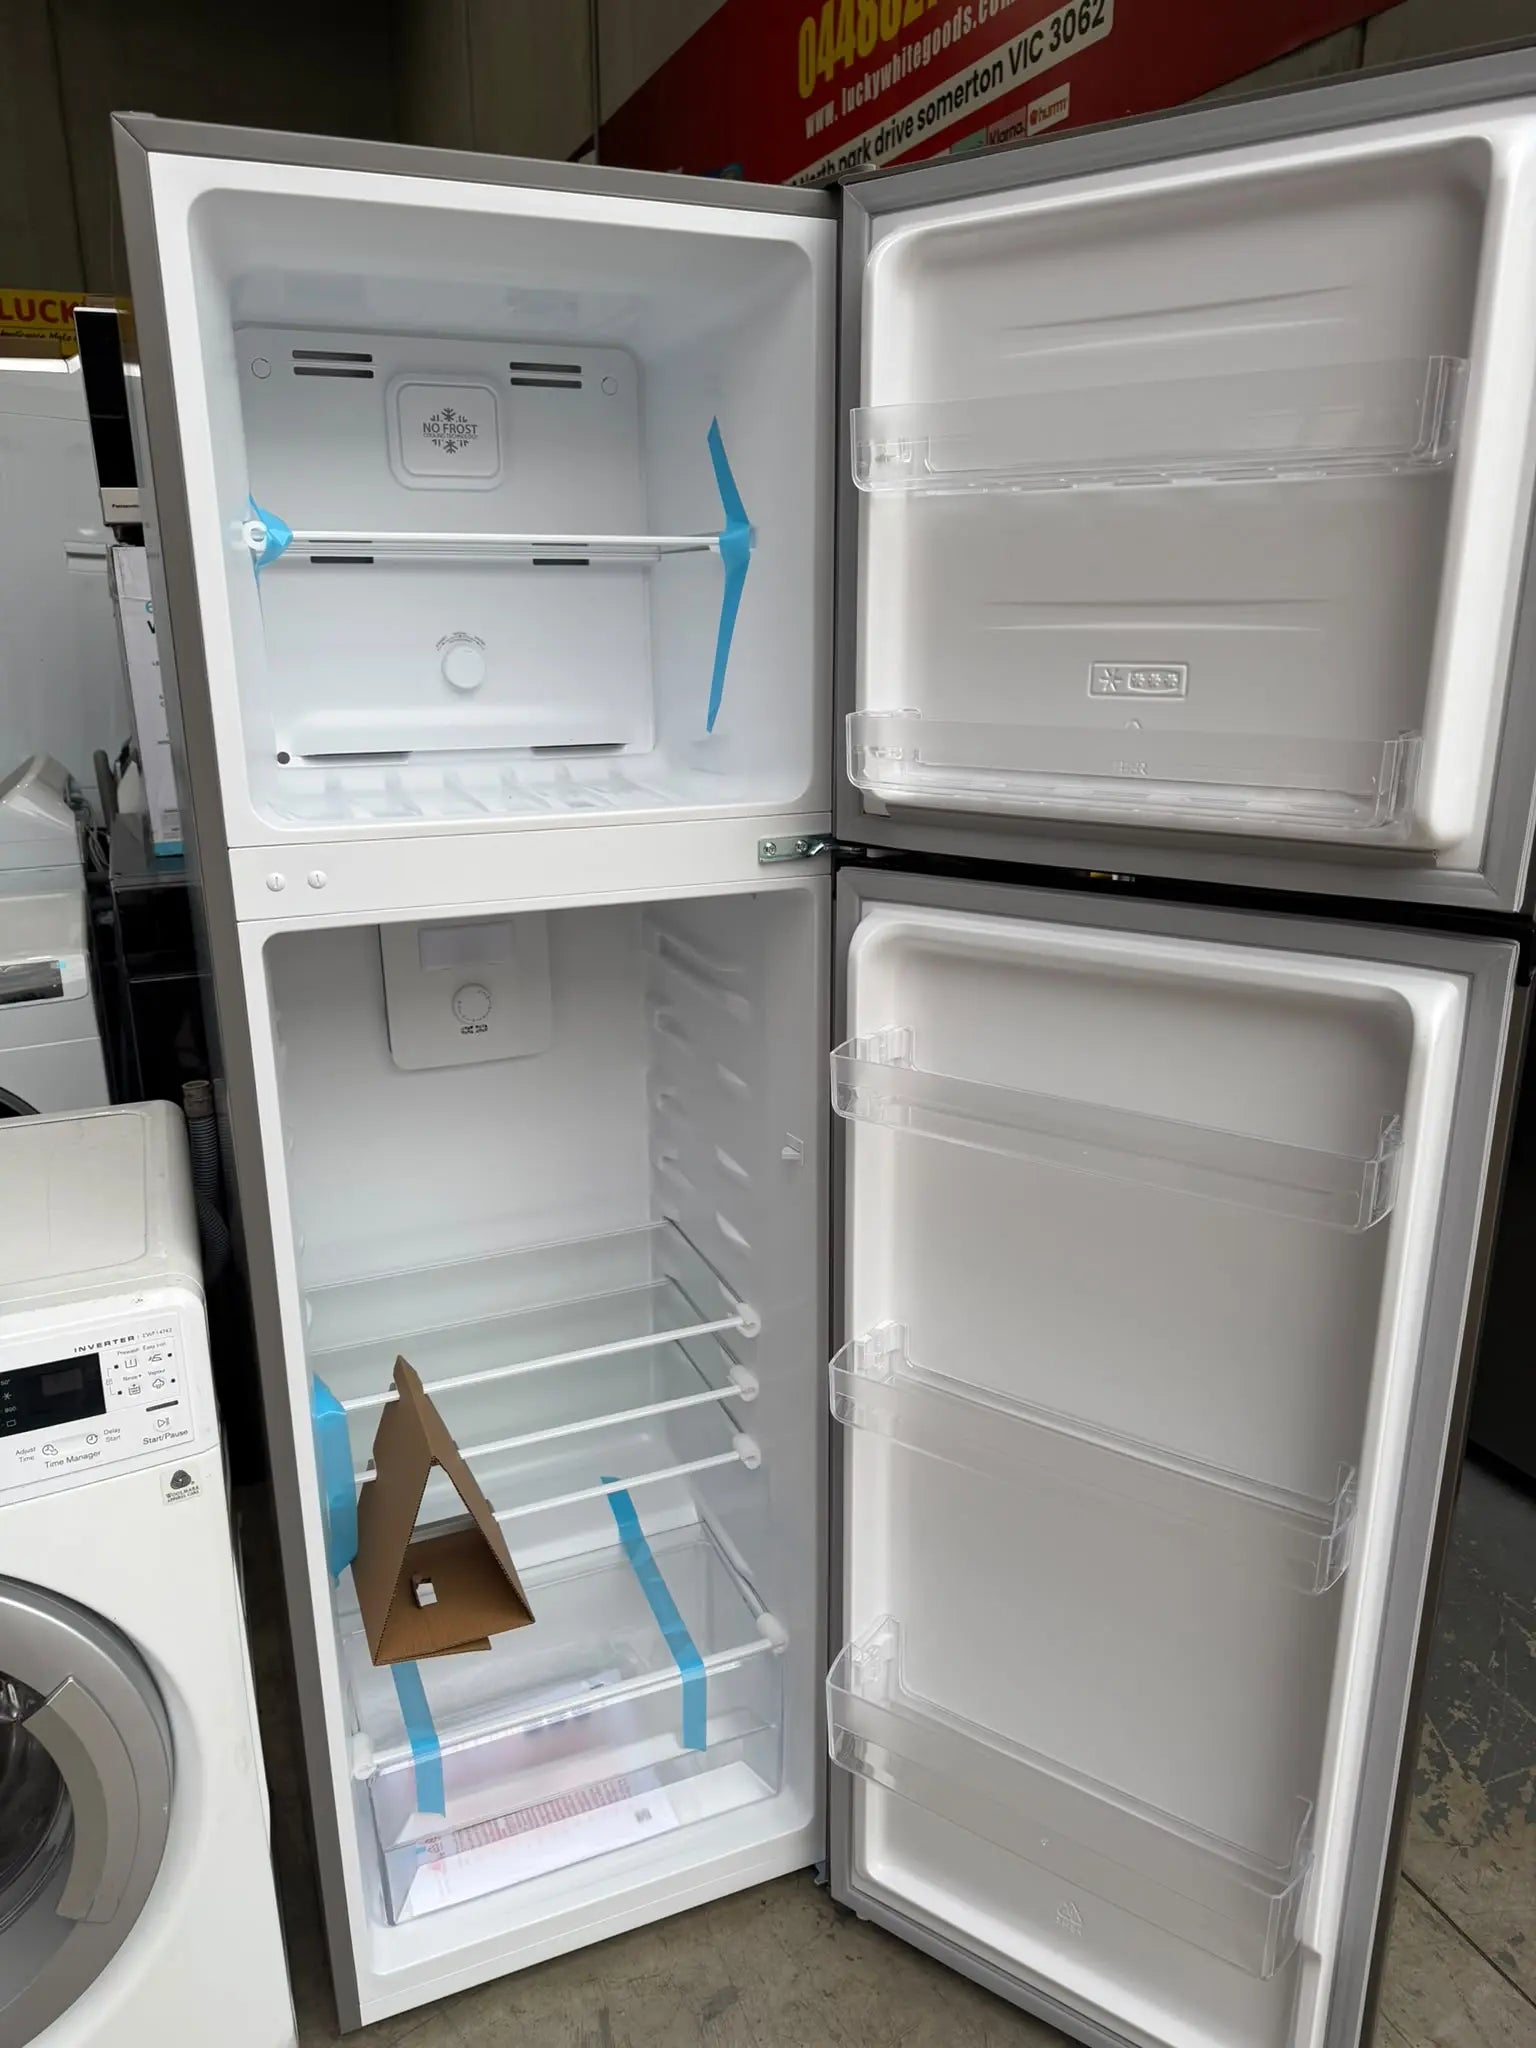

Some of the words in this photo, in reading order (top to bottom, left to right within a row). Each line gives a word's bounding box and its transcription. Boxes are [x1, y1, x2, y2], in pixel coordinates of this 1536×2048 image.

[842, 0, 1016, 116] luckywhitegoods.co
[839, 137, 871, 170] park
[875, 116, 913, 157] drive
[917, 59, 1003, 131] somerton
[1009, 30, 1044, 75] VIC
[1049, 0, 1104, 52] 3062
[423, 423, 440, 433] NO
[443, 424, 478, 434] FROST
[74, 1335, 135, 1353] INVERTER
[104, 1427, 121, 1436] Delay
[143, 1429, 189, 1446] Start/Pause
[15, 1446, 36, 1457] Adjust
[19, 1454, 35, 1463] Time
[44, 1458, 64, 1470] Time
[66, 1449, 102, 1466] Manager
